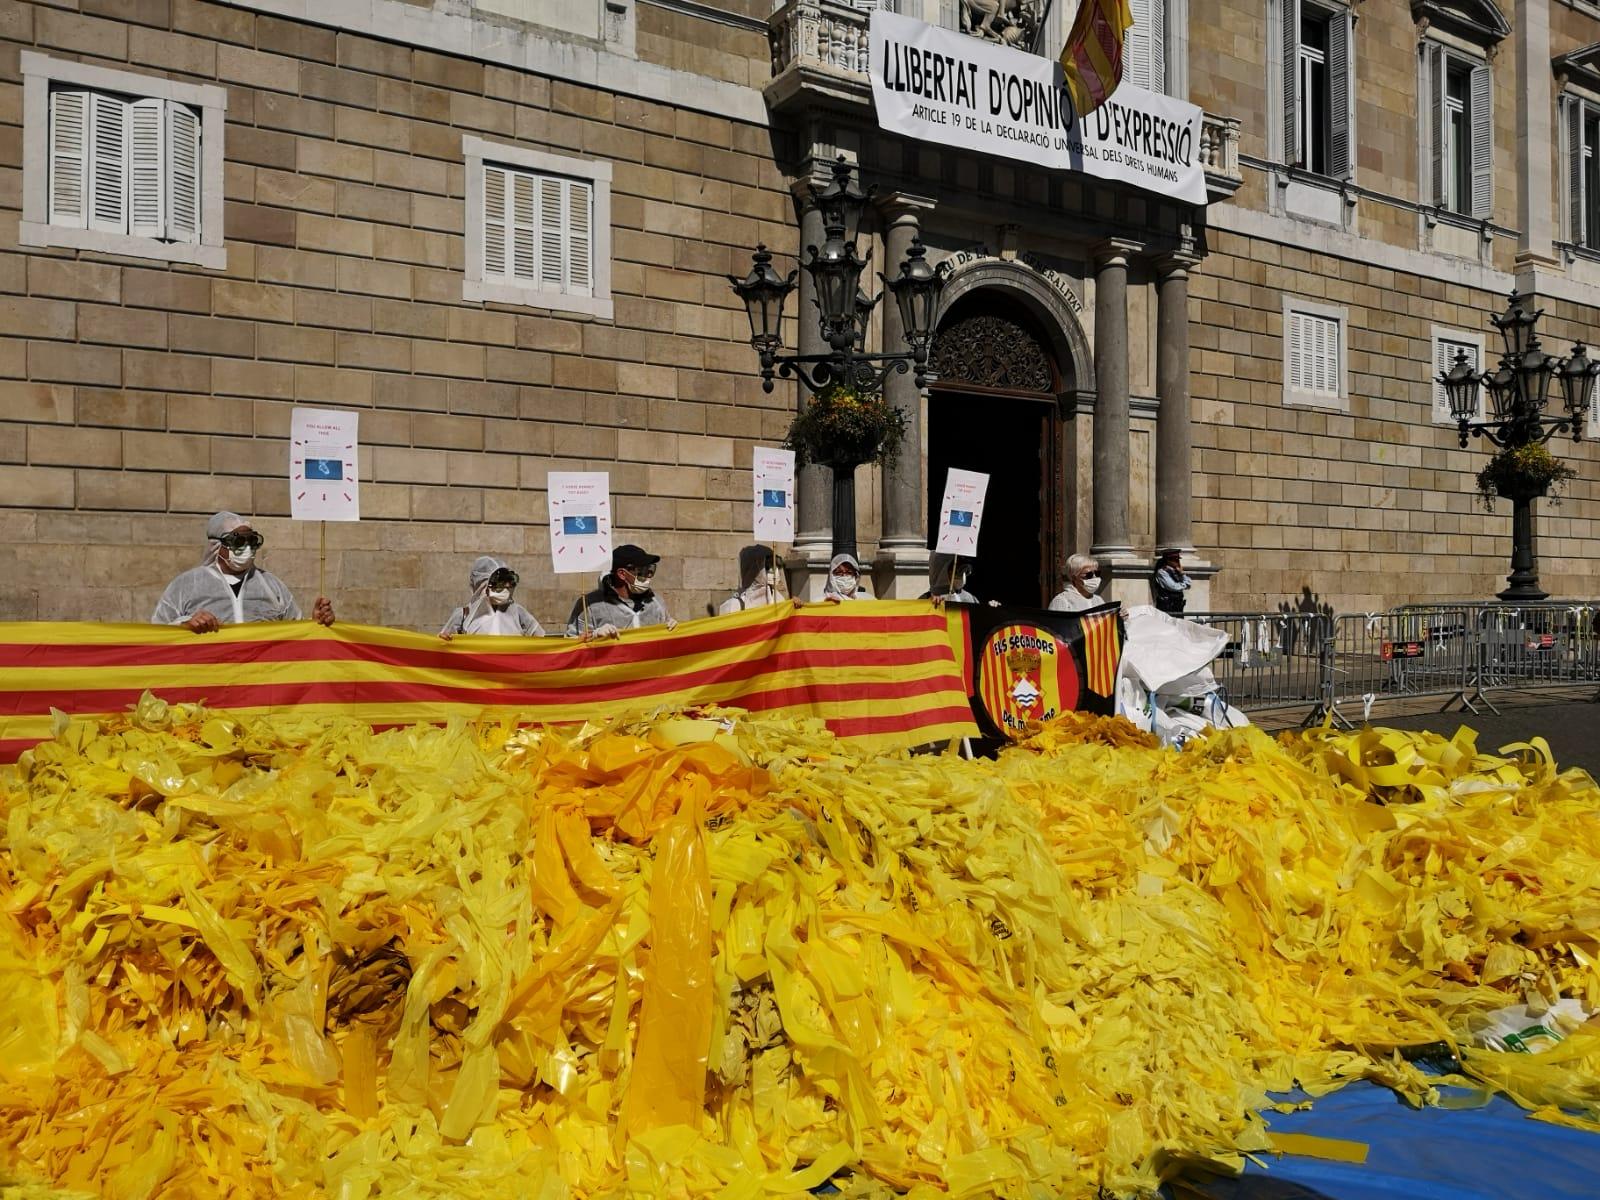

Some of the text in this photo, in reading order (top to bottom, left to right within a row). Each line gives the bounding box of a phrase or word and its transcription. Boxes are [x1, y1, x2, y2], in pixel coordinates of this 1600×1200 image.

[883, 39, 978, 110] LLIBERTAT
[989, 69, 1073, 133] D'OPINIÓ
[1096, 100, 1193, 168] D'EXPRESSIÓ
[911, 103, 1179, 183] ARTICLE 19 DE LA DECLARACIÓ UNIVERSAL DELS DRETS HUMANS
[956, 251, 973, 265] DE
